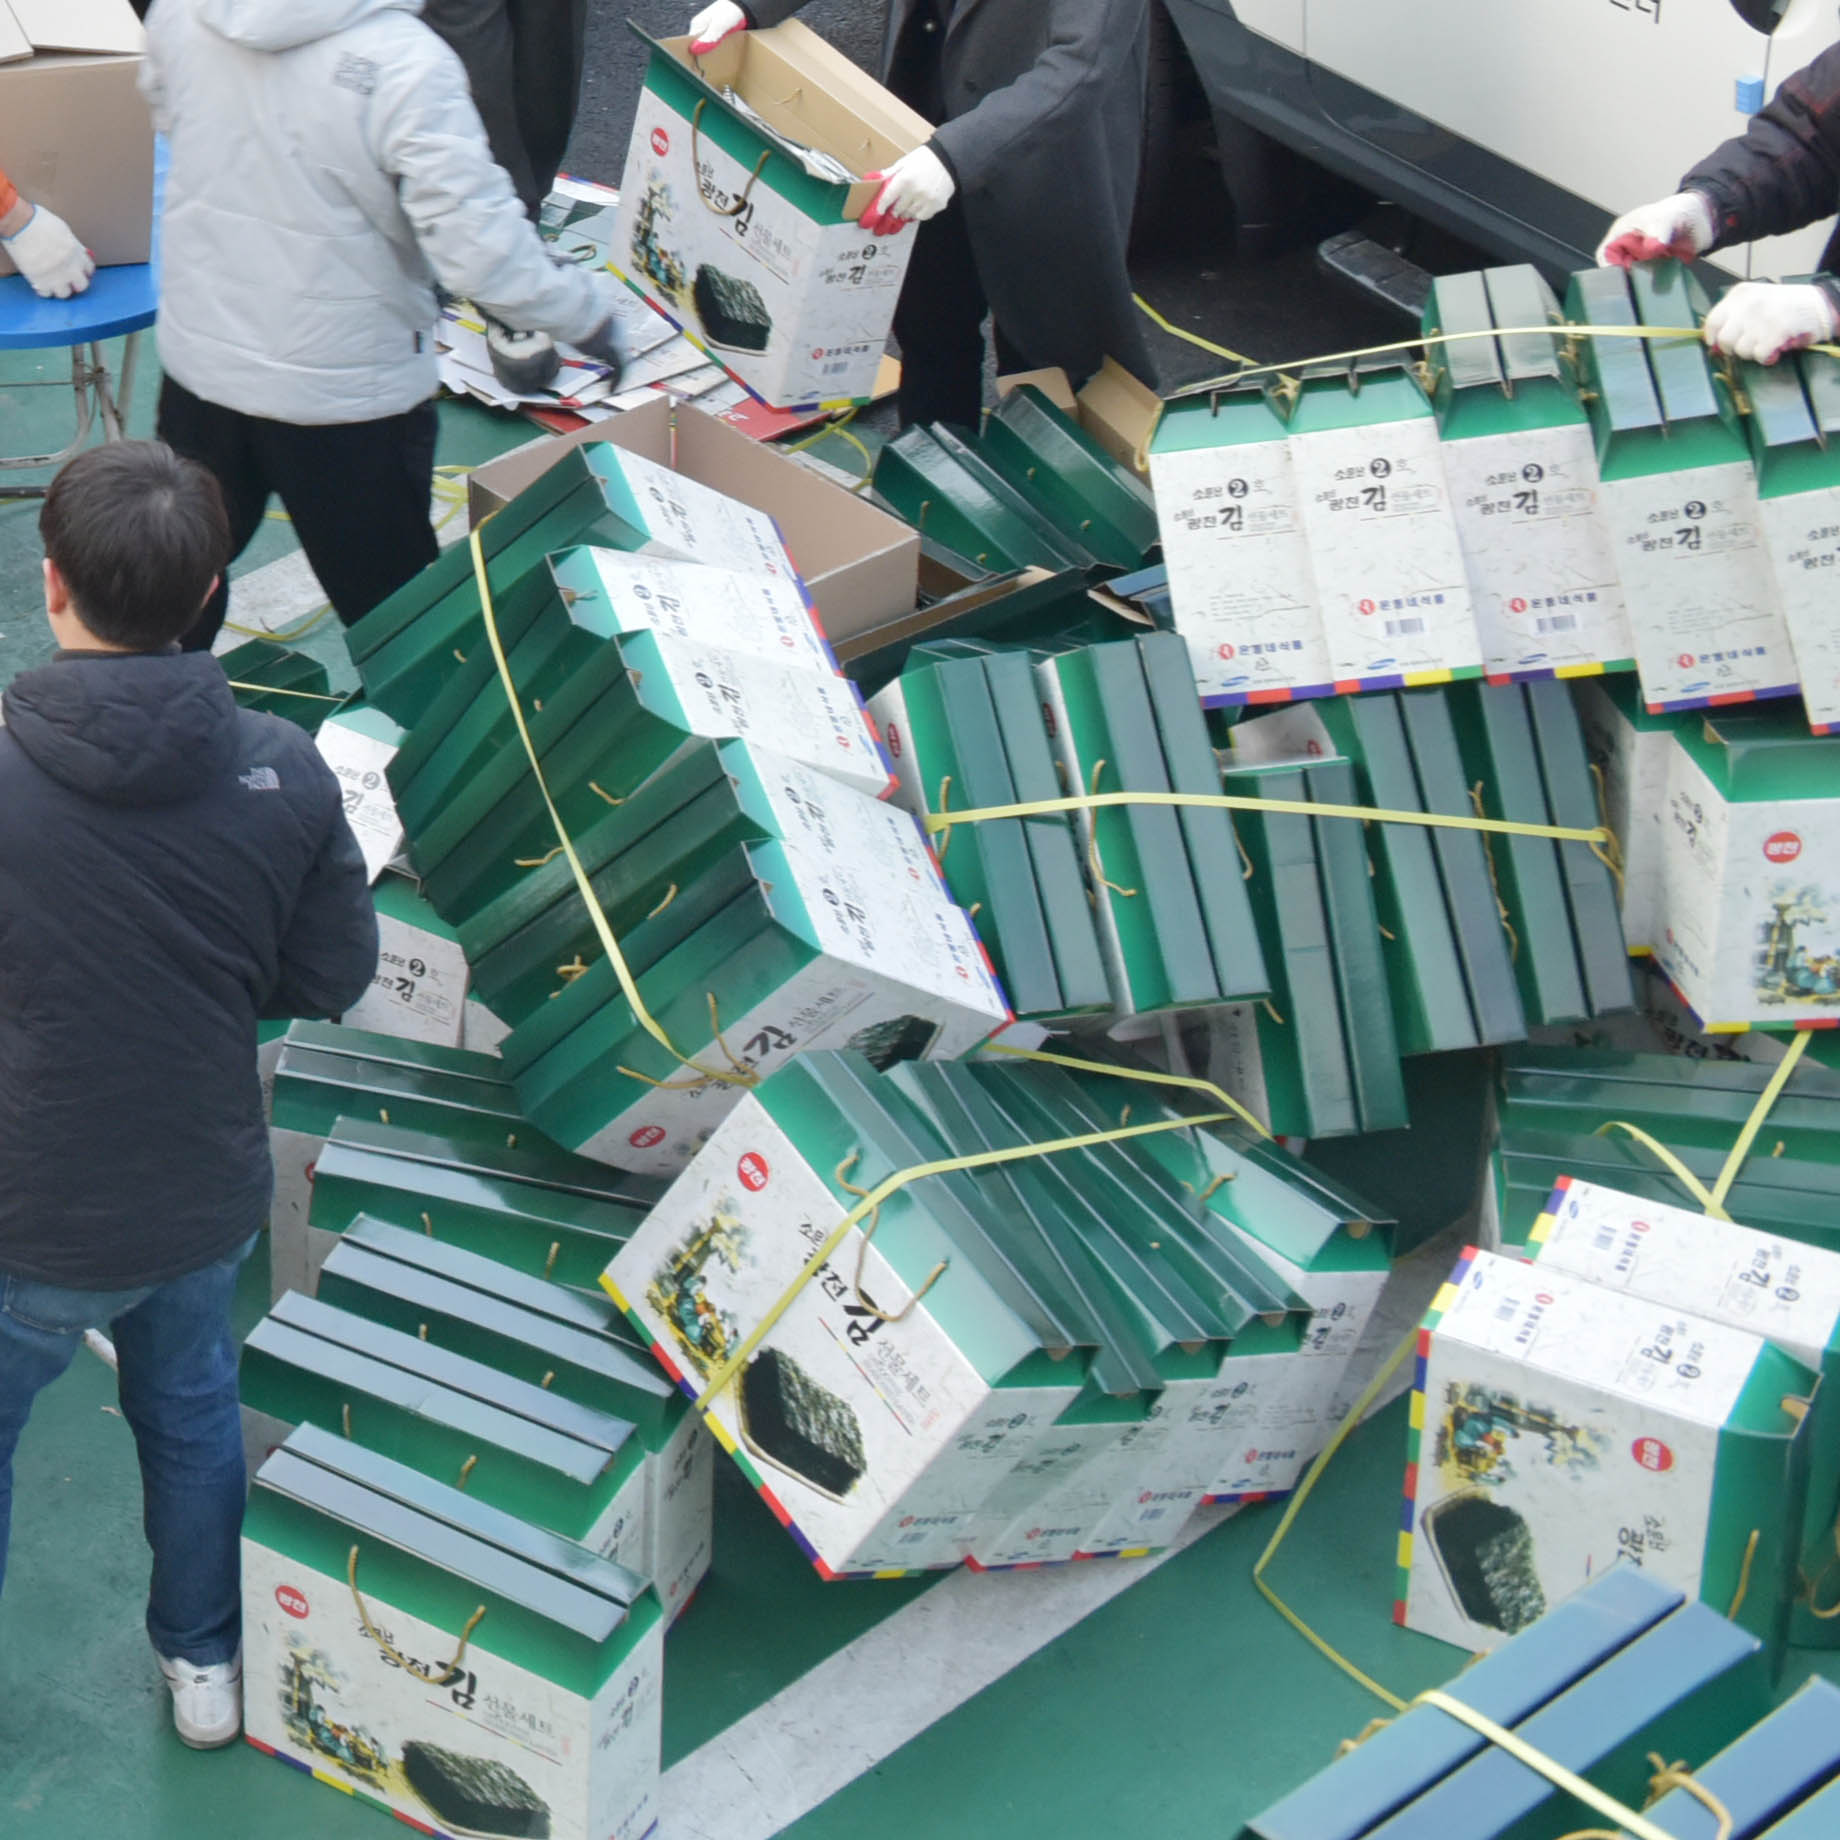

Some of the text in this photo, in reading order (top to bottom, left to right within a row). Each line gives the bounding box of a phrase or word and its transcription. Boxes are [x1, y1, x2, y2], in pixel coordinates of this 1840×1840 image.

[731, 192, 754, 237] 김
[849, 265, 867, 285] 김
[1360, 485, 1386, 512] 김
[1512, 489, 1539, 515] 김
[1218, 505, 1243, 531] 김
[1675, 526, 1702, 551] 김
[395, 976, 417, 1003] 김
[742, 1025, 798, 1056] 김
[842, 1287, 887, 1346] 김
[434, 1660, 477, 1710] 김
